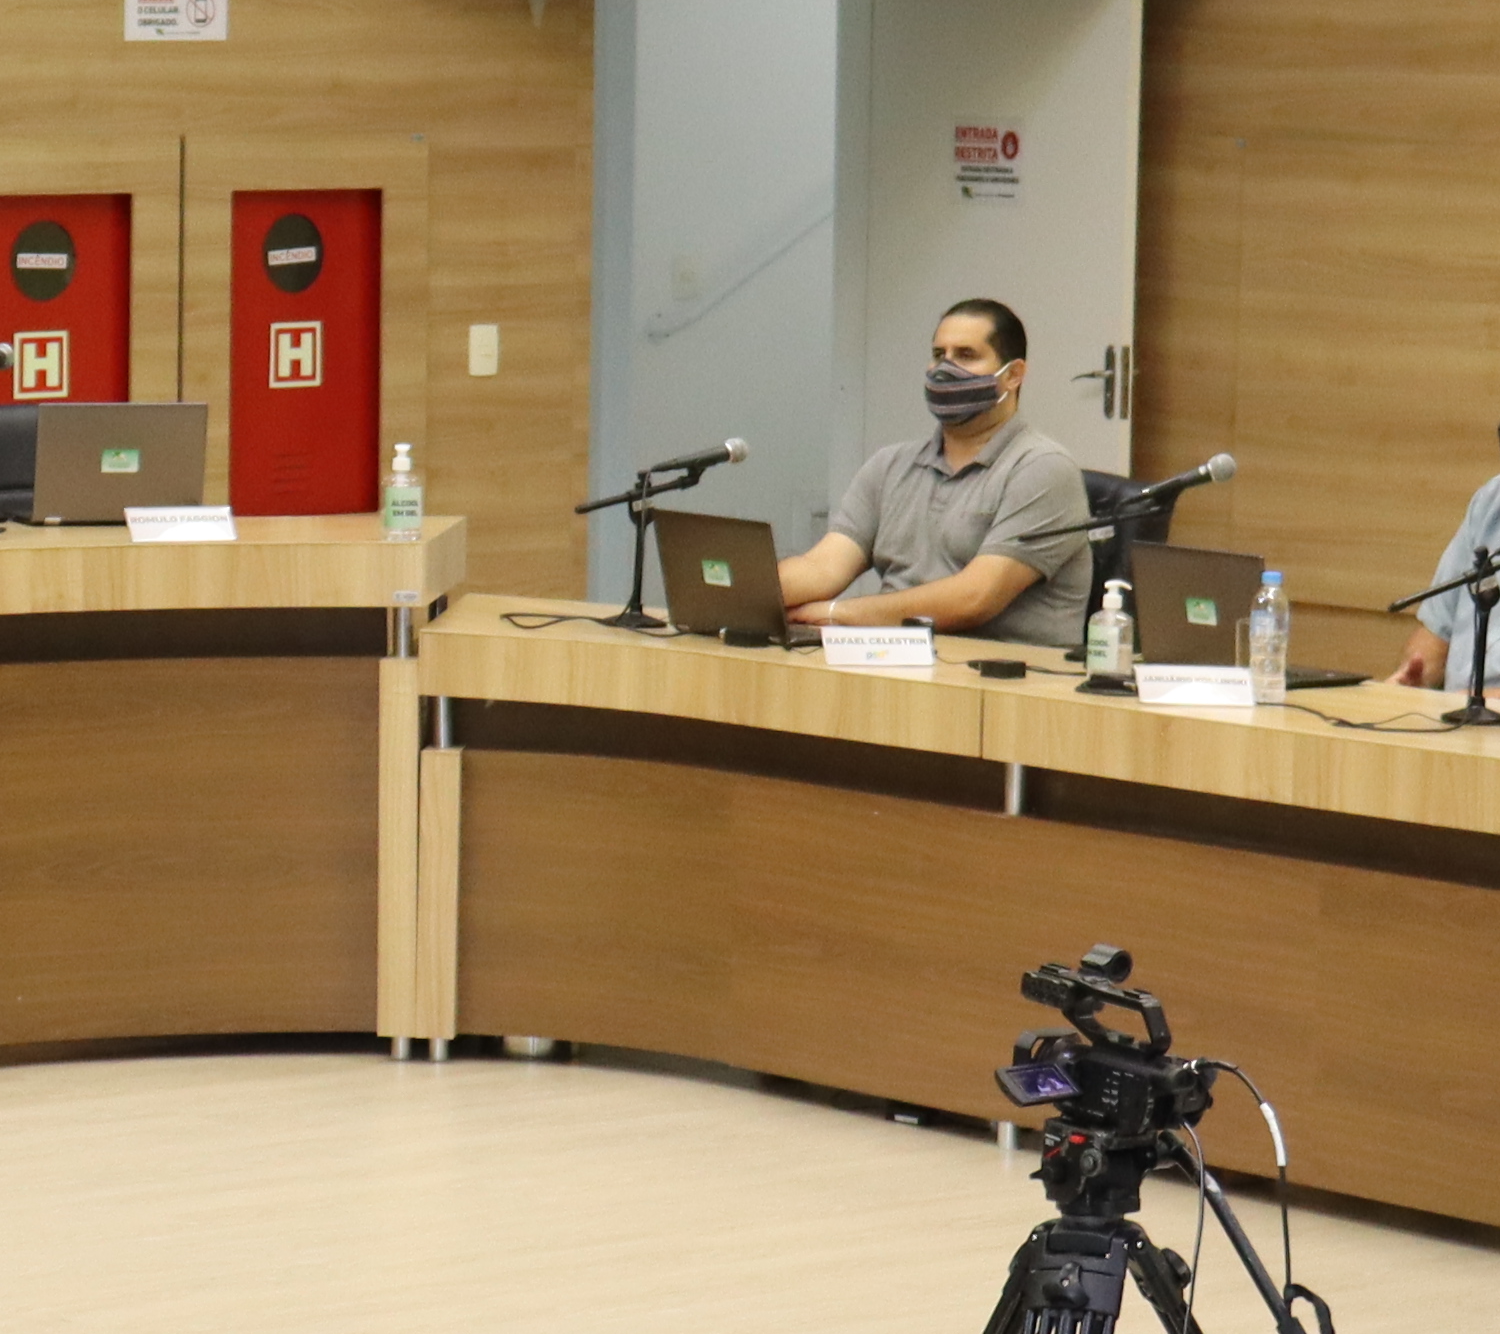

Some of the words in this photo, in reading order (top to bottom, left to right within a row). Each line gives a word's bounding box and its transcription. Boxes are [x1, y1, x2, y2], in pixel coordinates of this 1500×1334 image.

[144, 5, 179, 15] CELULAR
[17, 253, 67, 267] INCÊNDIO
[269, 249, 316, 264] INCÊNDIO
[278, 331, 314, 378] H
[22, 341, 61, 389] H
[825, 636, 865, 645] RAFAEL
[868, 637, 928, 645] CELESTRIN
